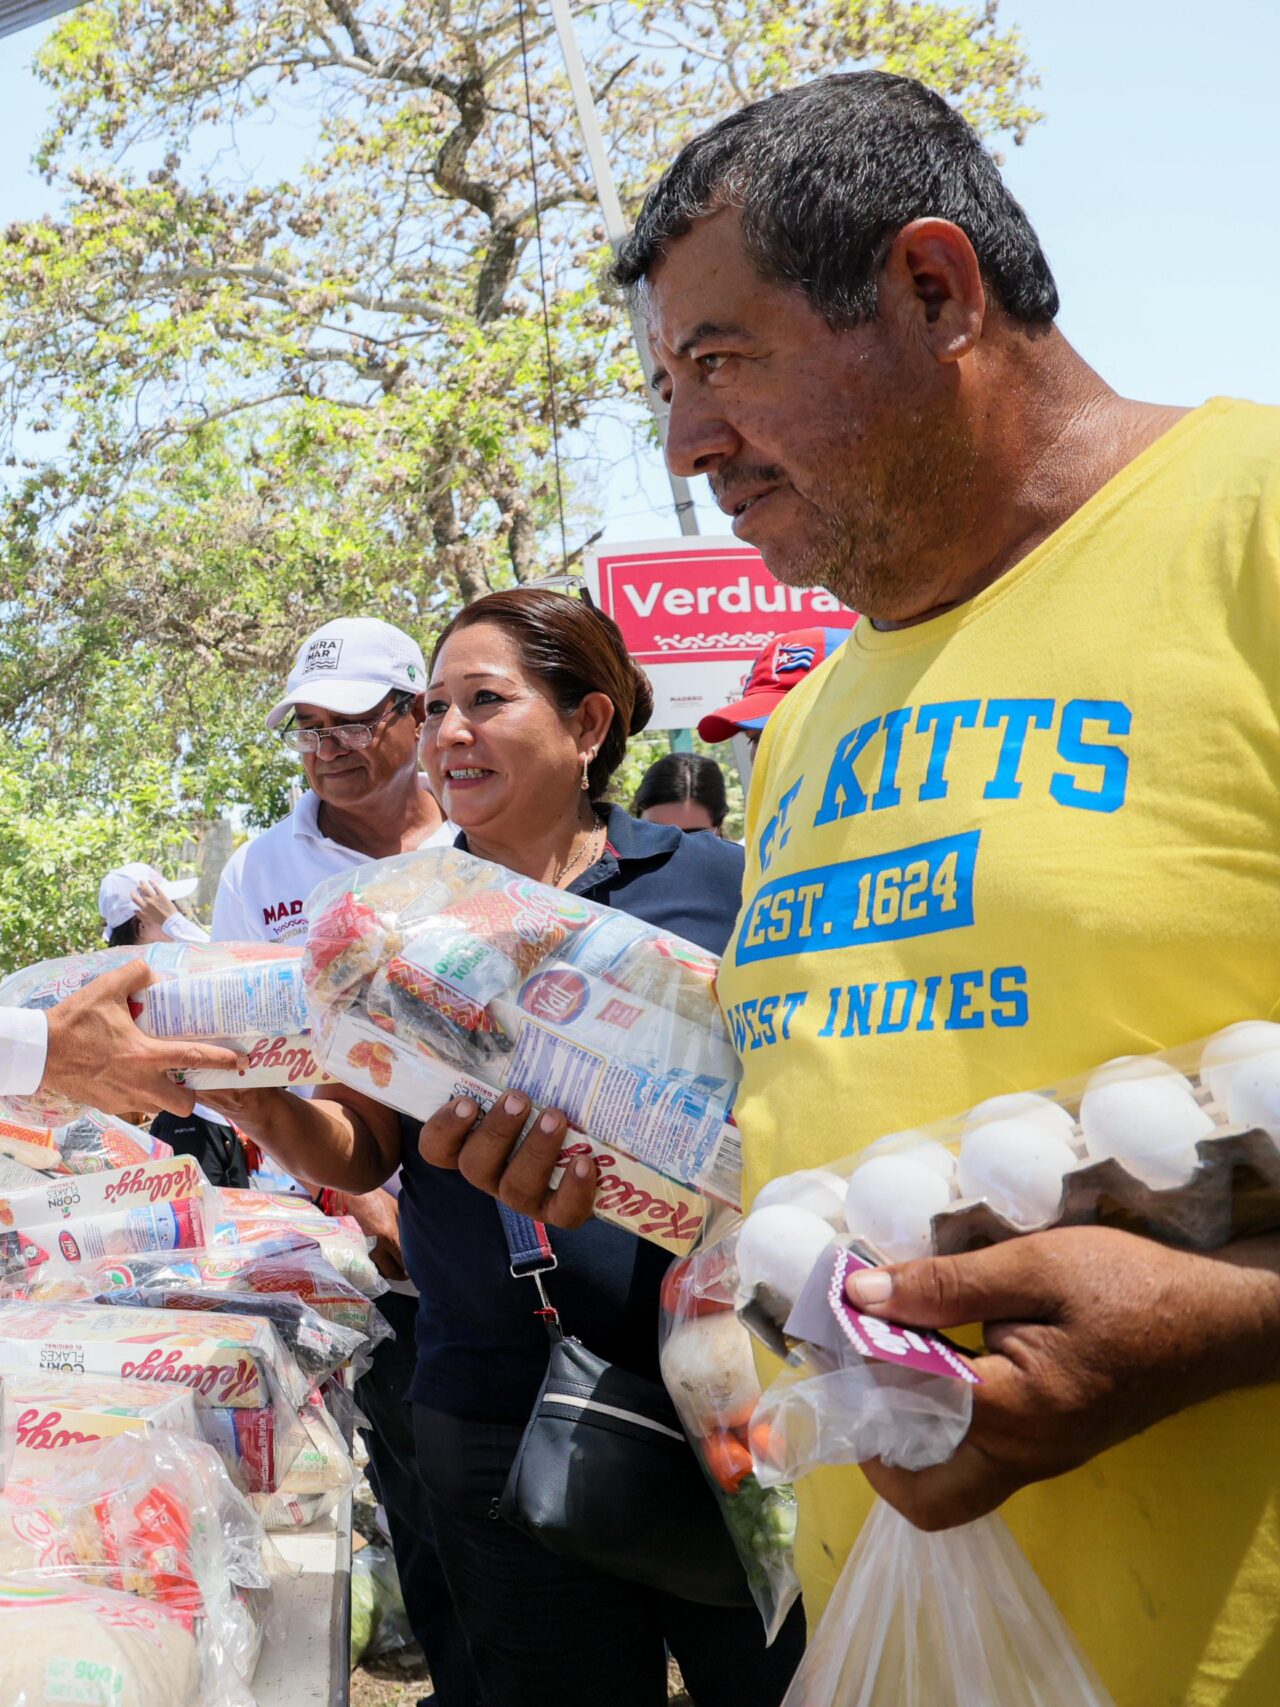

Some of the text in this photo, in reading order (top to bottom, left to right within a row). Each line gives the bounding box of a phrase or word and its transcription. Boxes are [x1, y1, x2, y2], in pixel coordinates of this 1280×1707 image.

[622, 577, 855, 618] Verdura
[307, 650, 330, 661] MAR
[310, 641, 336, 651] MIRA
[813, 698, 1132, 813] KITTS
[743, 851, 959, 949] EST. 1624
[726, 990, 808, 1054] WEST
[818, 965, 1029, 1038] INDIES
[48, 1194, 81, 1208] CORN
[40, 1350, 85, 1363] FLAKES
